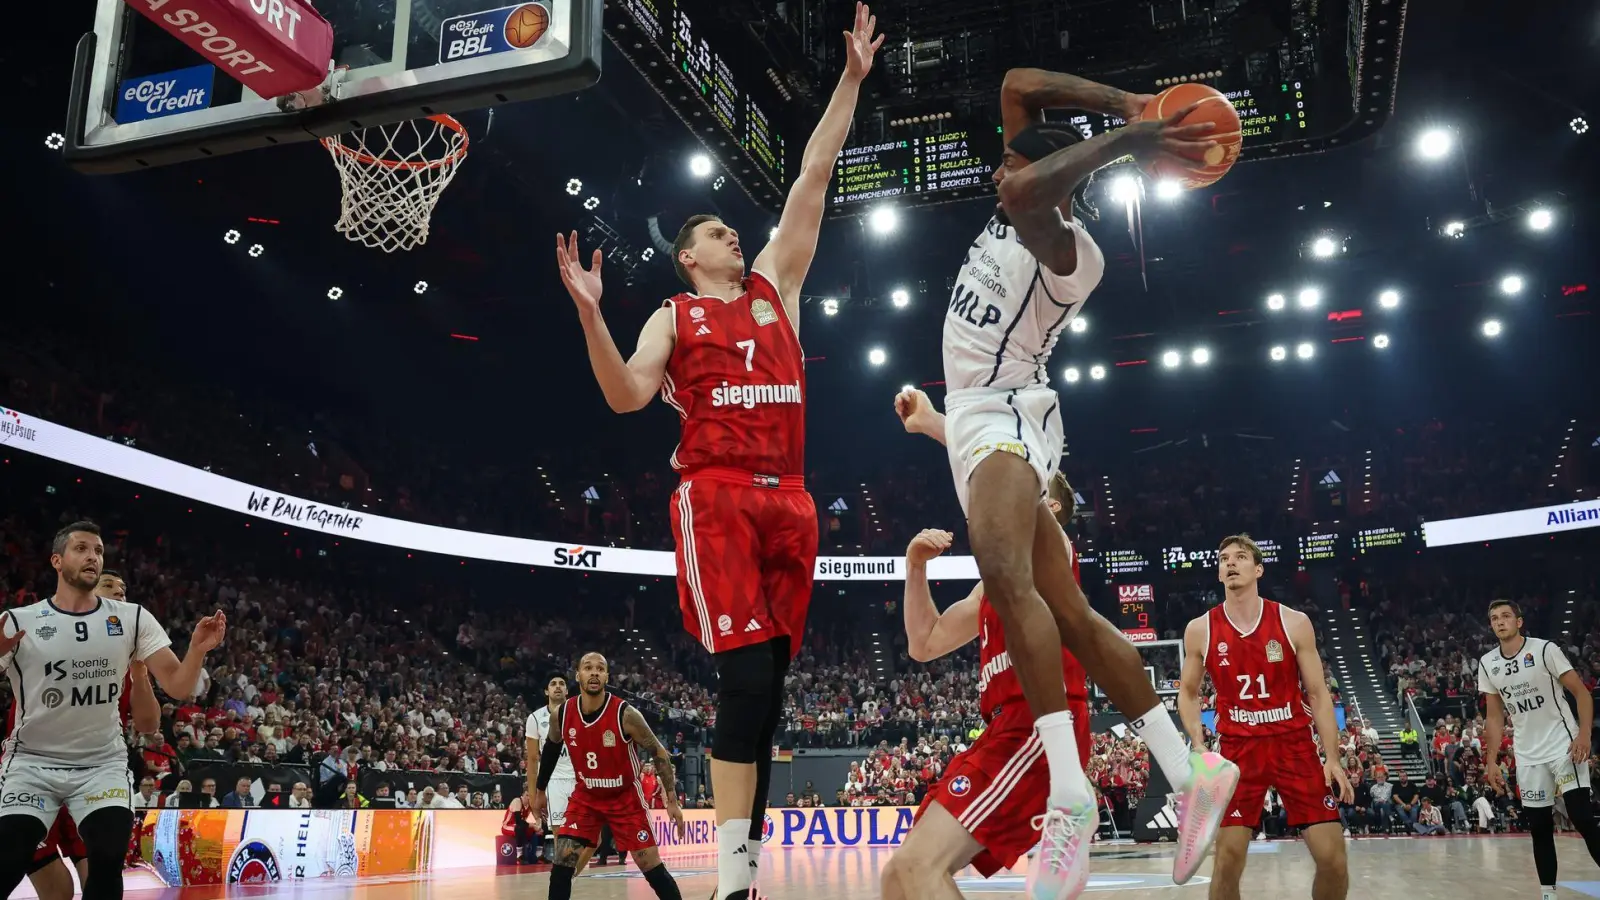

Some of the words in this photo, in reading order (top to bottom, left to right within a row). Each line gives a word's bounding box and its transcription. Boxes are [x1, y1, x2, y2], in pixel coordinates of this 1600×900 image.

[250, 0, 301, 40] ORT
[462, 24, 494, 37] Credit
[679, 20, 692, 48] 24
[163, 8, 275, 75] SPORT
[447, 35, 492, 59] BBL
[699, 46, 711, 72] 13
[146, 88, 205, 114] Credit
[1231, 100, 1246, 108] SEK
[1103, 119, 1110, 127] 2
[1240, 117, 1267, 126] THERS
[925, 136, 936, 144] 11
[938, 133, 960, 142] LUCIC
[1242, 127, 1261, 136] SELL
[902, 140, 908, 148] 1
[913, 138, 919, 146] 3
[938, 141, 958, 151] OBST
[845, 155, 870, 165] WHITE
[939, 150, 960, 160] BITIM
[846, 164, 872, 174] GIFFEY
[940, 158, 973, 169] HOLLATZ
[846, 171, 889, 183] VOIGTMANN
[927, 173, 937, 181] 22
[940, 166, 983, 179] BRANKOVIC
[846, 182, 874, 192] NAPIER
[927, 182, 938, 190] 31
[940, 177, 972, 188] BOOKER
[846, 187, 902, 201] KHARCHENKOV
[969, 266, 1008, 298] solutions
[950, 283, 1002, 328] MLP
[735, 339, 756, 372] 7
[247, 490, 271, 512] WE
[272, 496, 303, 520] BALL
[1547, 507, 1600, 526] Allian
[1168, 552, 1186, 563] 24
[819, 559, 895, 578] siegmund
[1138, 613, 1148, 627] 9
[75, 621, 89, 642] 9
[72, 657, 109, 669] koenig
[1505, 659, 1519, 676] 33
[72, 668, 117, 680] solutions
[71, 682, 119, 706] MLP
[1236, 674, 1270, 700] 21
[1517, 695, 1545, 713] MLP
[1229, 702, 1293, 726] siegmund
[586, 751, 598, 769] 8
